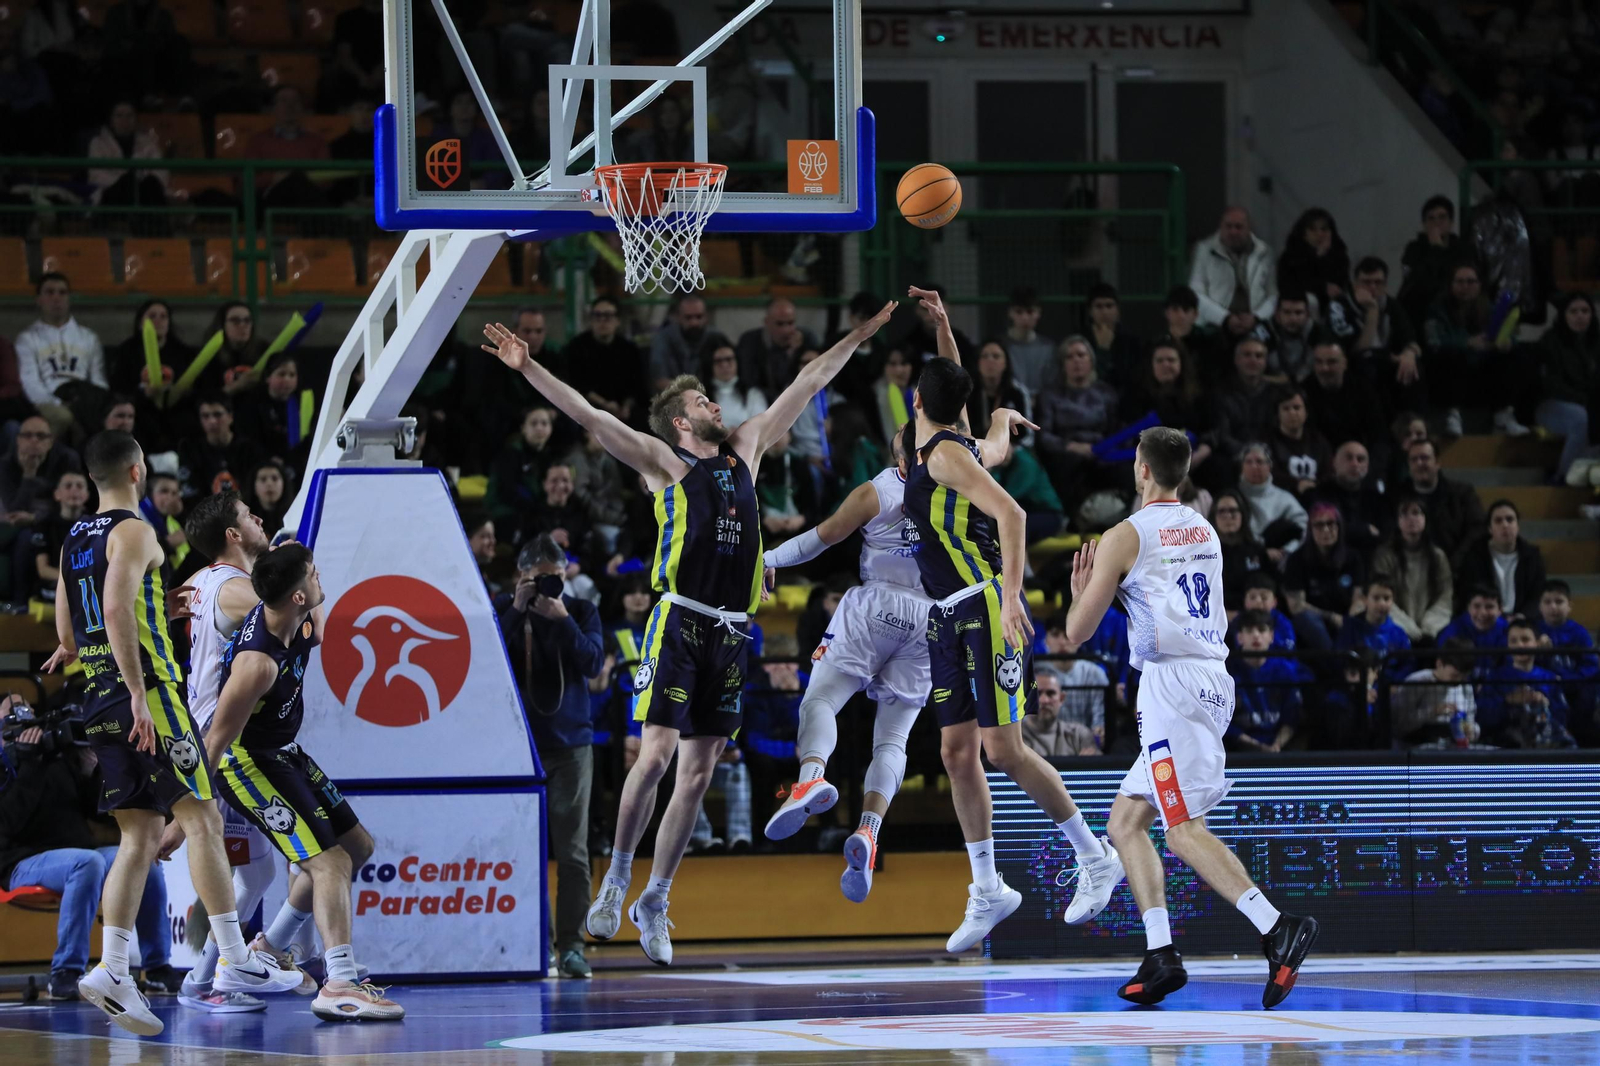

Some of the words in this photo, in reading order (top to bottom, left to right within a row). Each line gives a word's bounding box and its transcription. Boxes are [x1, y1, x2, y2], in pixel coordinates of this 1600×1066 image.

[864, 18, 910, 46] DE
[976, 22, 1220, 49] EMERXENCIA
[78, 575, 105, 634] 11
[79, 642, 113, 658] ABAN
[356, 886, 516, 916] Paradelo
